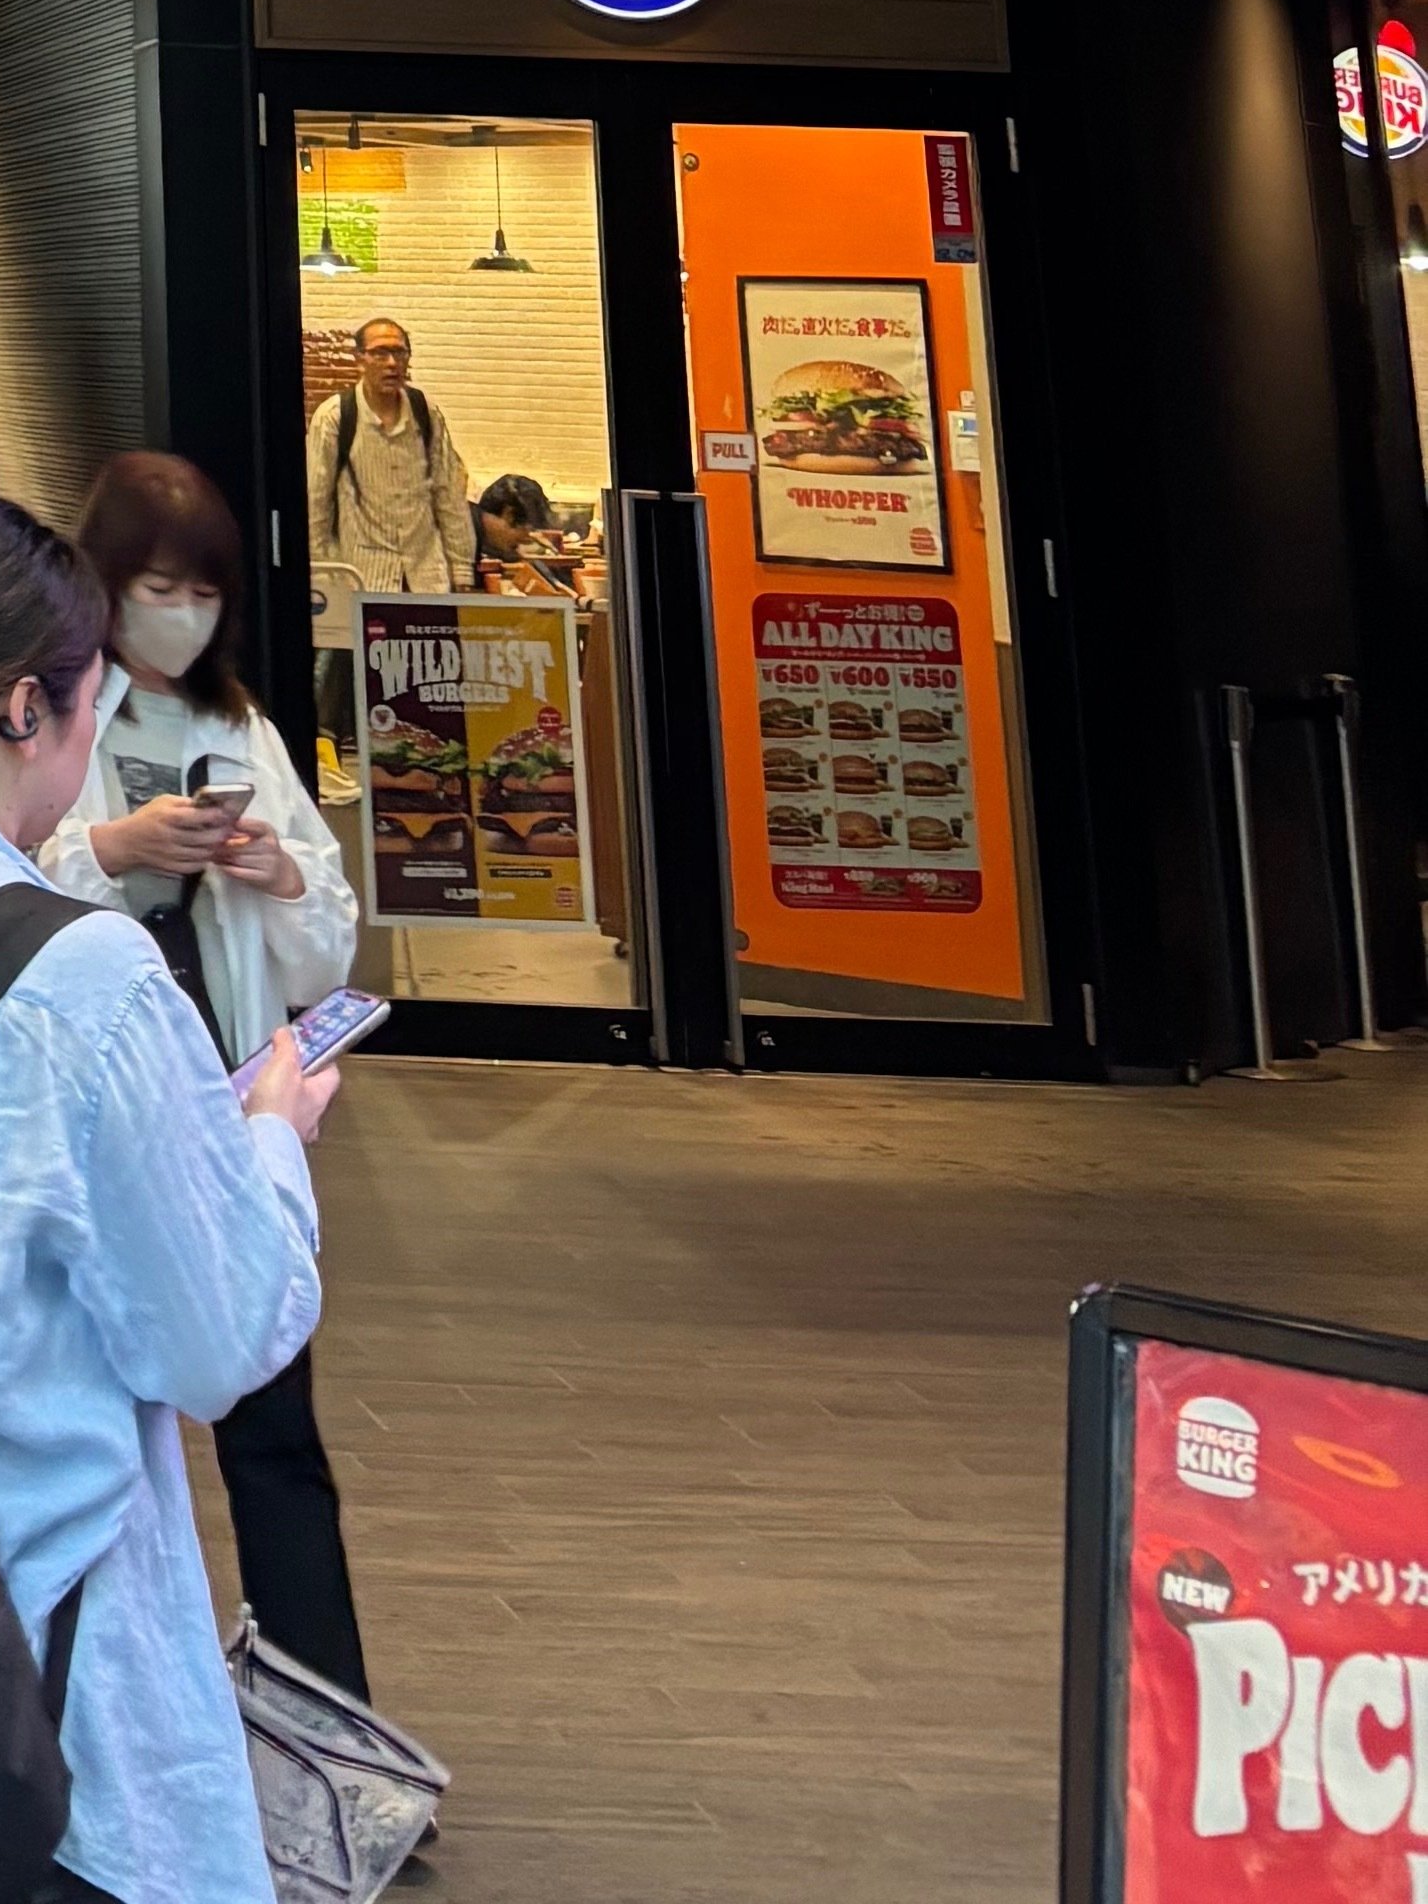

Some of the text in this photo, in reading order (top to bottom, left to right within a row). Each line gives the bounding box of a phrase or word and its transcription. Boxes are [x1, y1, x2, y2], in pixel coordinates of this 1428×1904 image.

[711, 442, 749, 460] PULL
[787, 487, 910, 513] WHOPPER
[762, 620, 954, 653] ALL DAY KING
[369, 638, 555, 703] WILD WEST
[419, 682, 510, 704] BURGERS
[1178, 1419, 1259, 1456] BURGER
[1177, 1441, 1258, 1483] KING
[1160, 1571, 1231, 1616] NEW
[1186, 1618, 1428, 1838] PIC
